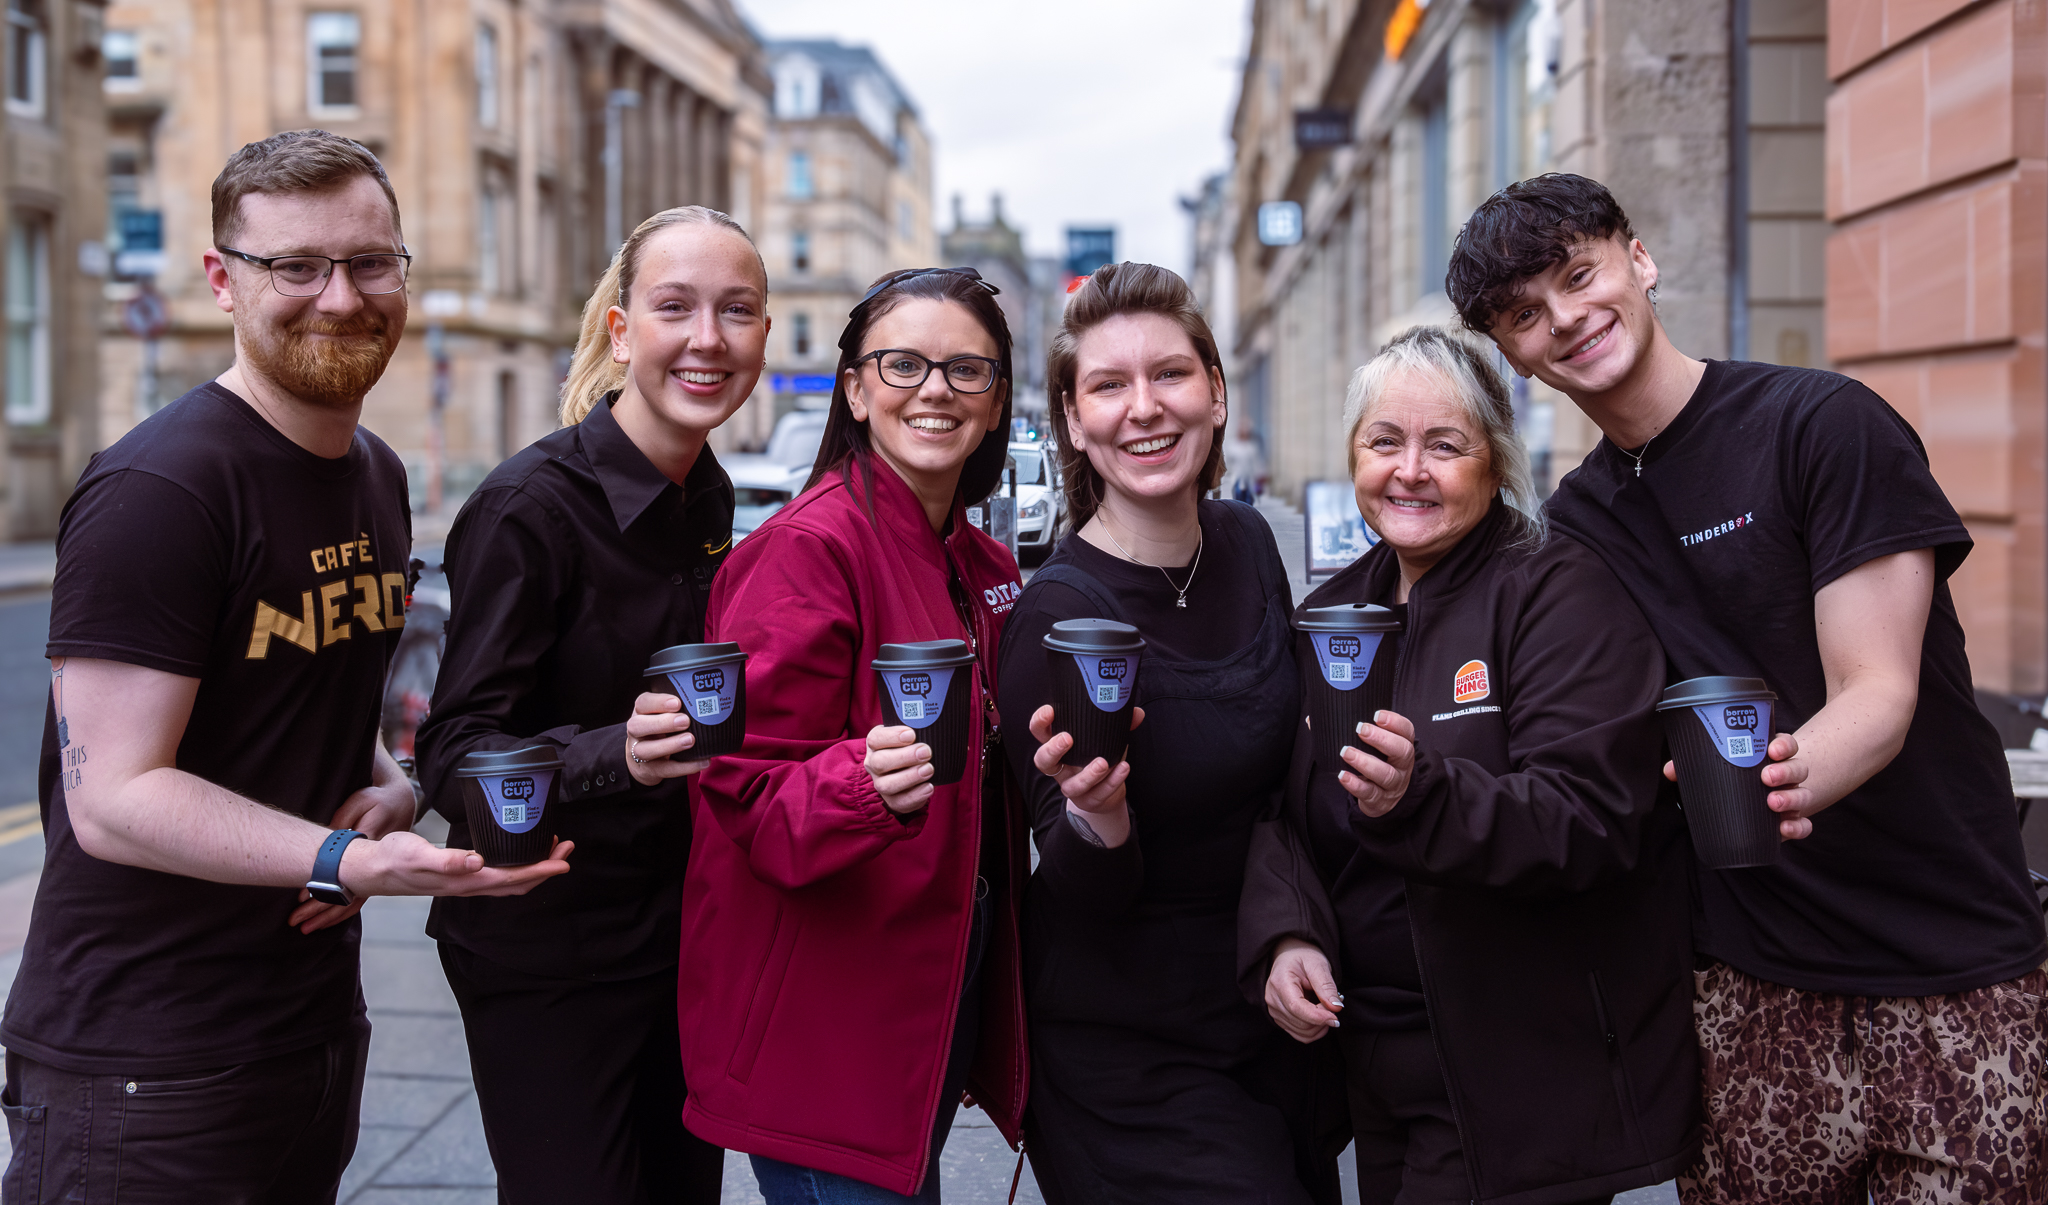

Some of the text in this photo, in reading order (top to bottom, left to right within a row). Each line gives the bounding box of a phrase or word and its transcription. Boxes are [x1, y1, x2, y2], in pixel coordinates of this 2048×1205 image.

[245, 572, 406, 660] NERO
[694, 671, 721, 680] borrow
[1456, 670, 1486, 686] BURGER
[1456, 679, 1488, 696] KING
[1726, 708, 1755, 717] borrow
[66, 745, 87, 767] THIS
